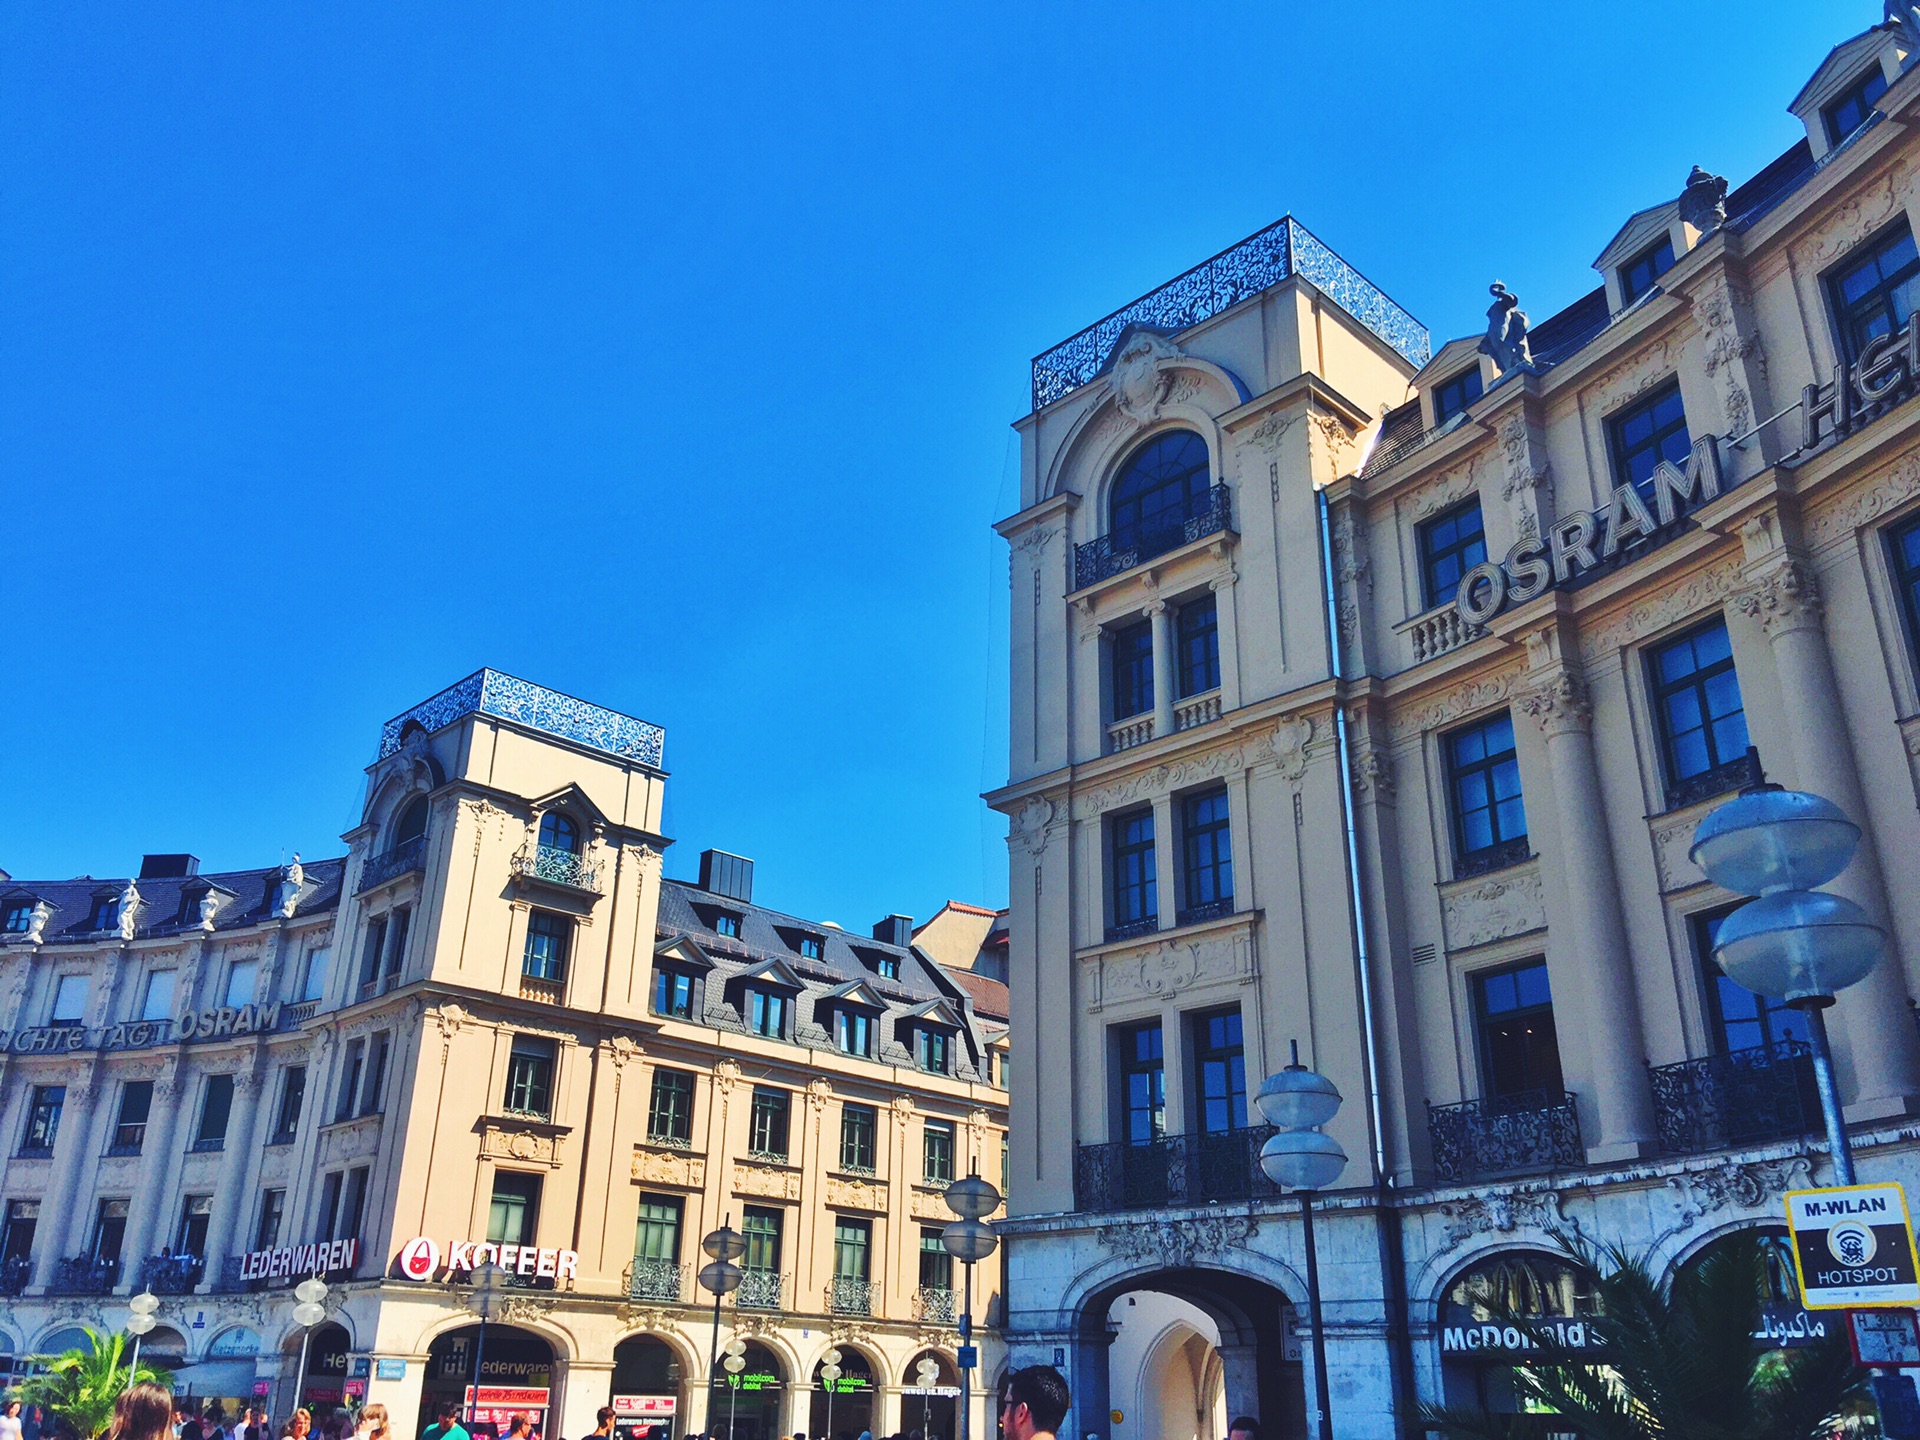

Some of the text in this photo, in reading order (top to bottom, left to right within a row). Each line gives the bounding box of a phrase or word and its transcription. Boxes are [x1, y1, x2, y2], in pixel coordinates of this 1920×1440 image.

[1456, 433, 1722, 625] OSRAM
[175, 1001, 283, 1040] OSRAM
[1805, 1198, 1887, 1217] M-WLAN
[240, 1238, 356, 1281] LEDERWAREN
[449, 1241, 579, 1279] KOFFER
[1817, 1267, 1898, 1285] HOTSPOT
[480, 1361, 553, 1376] ederware
